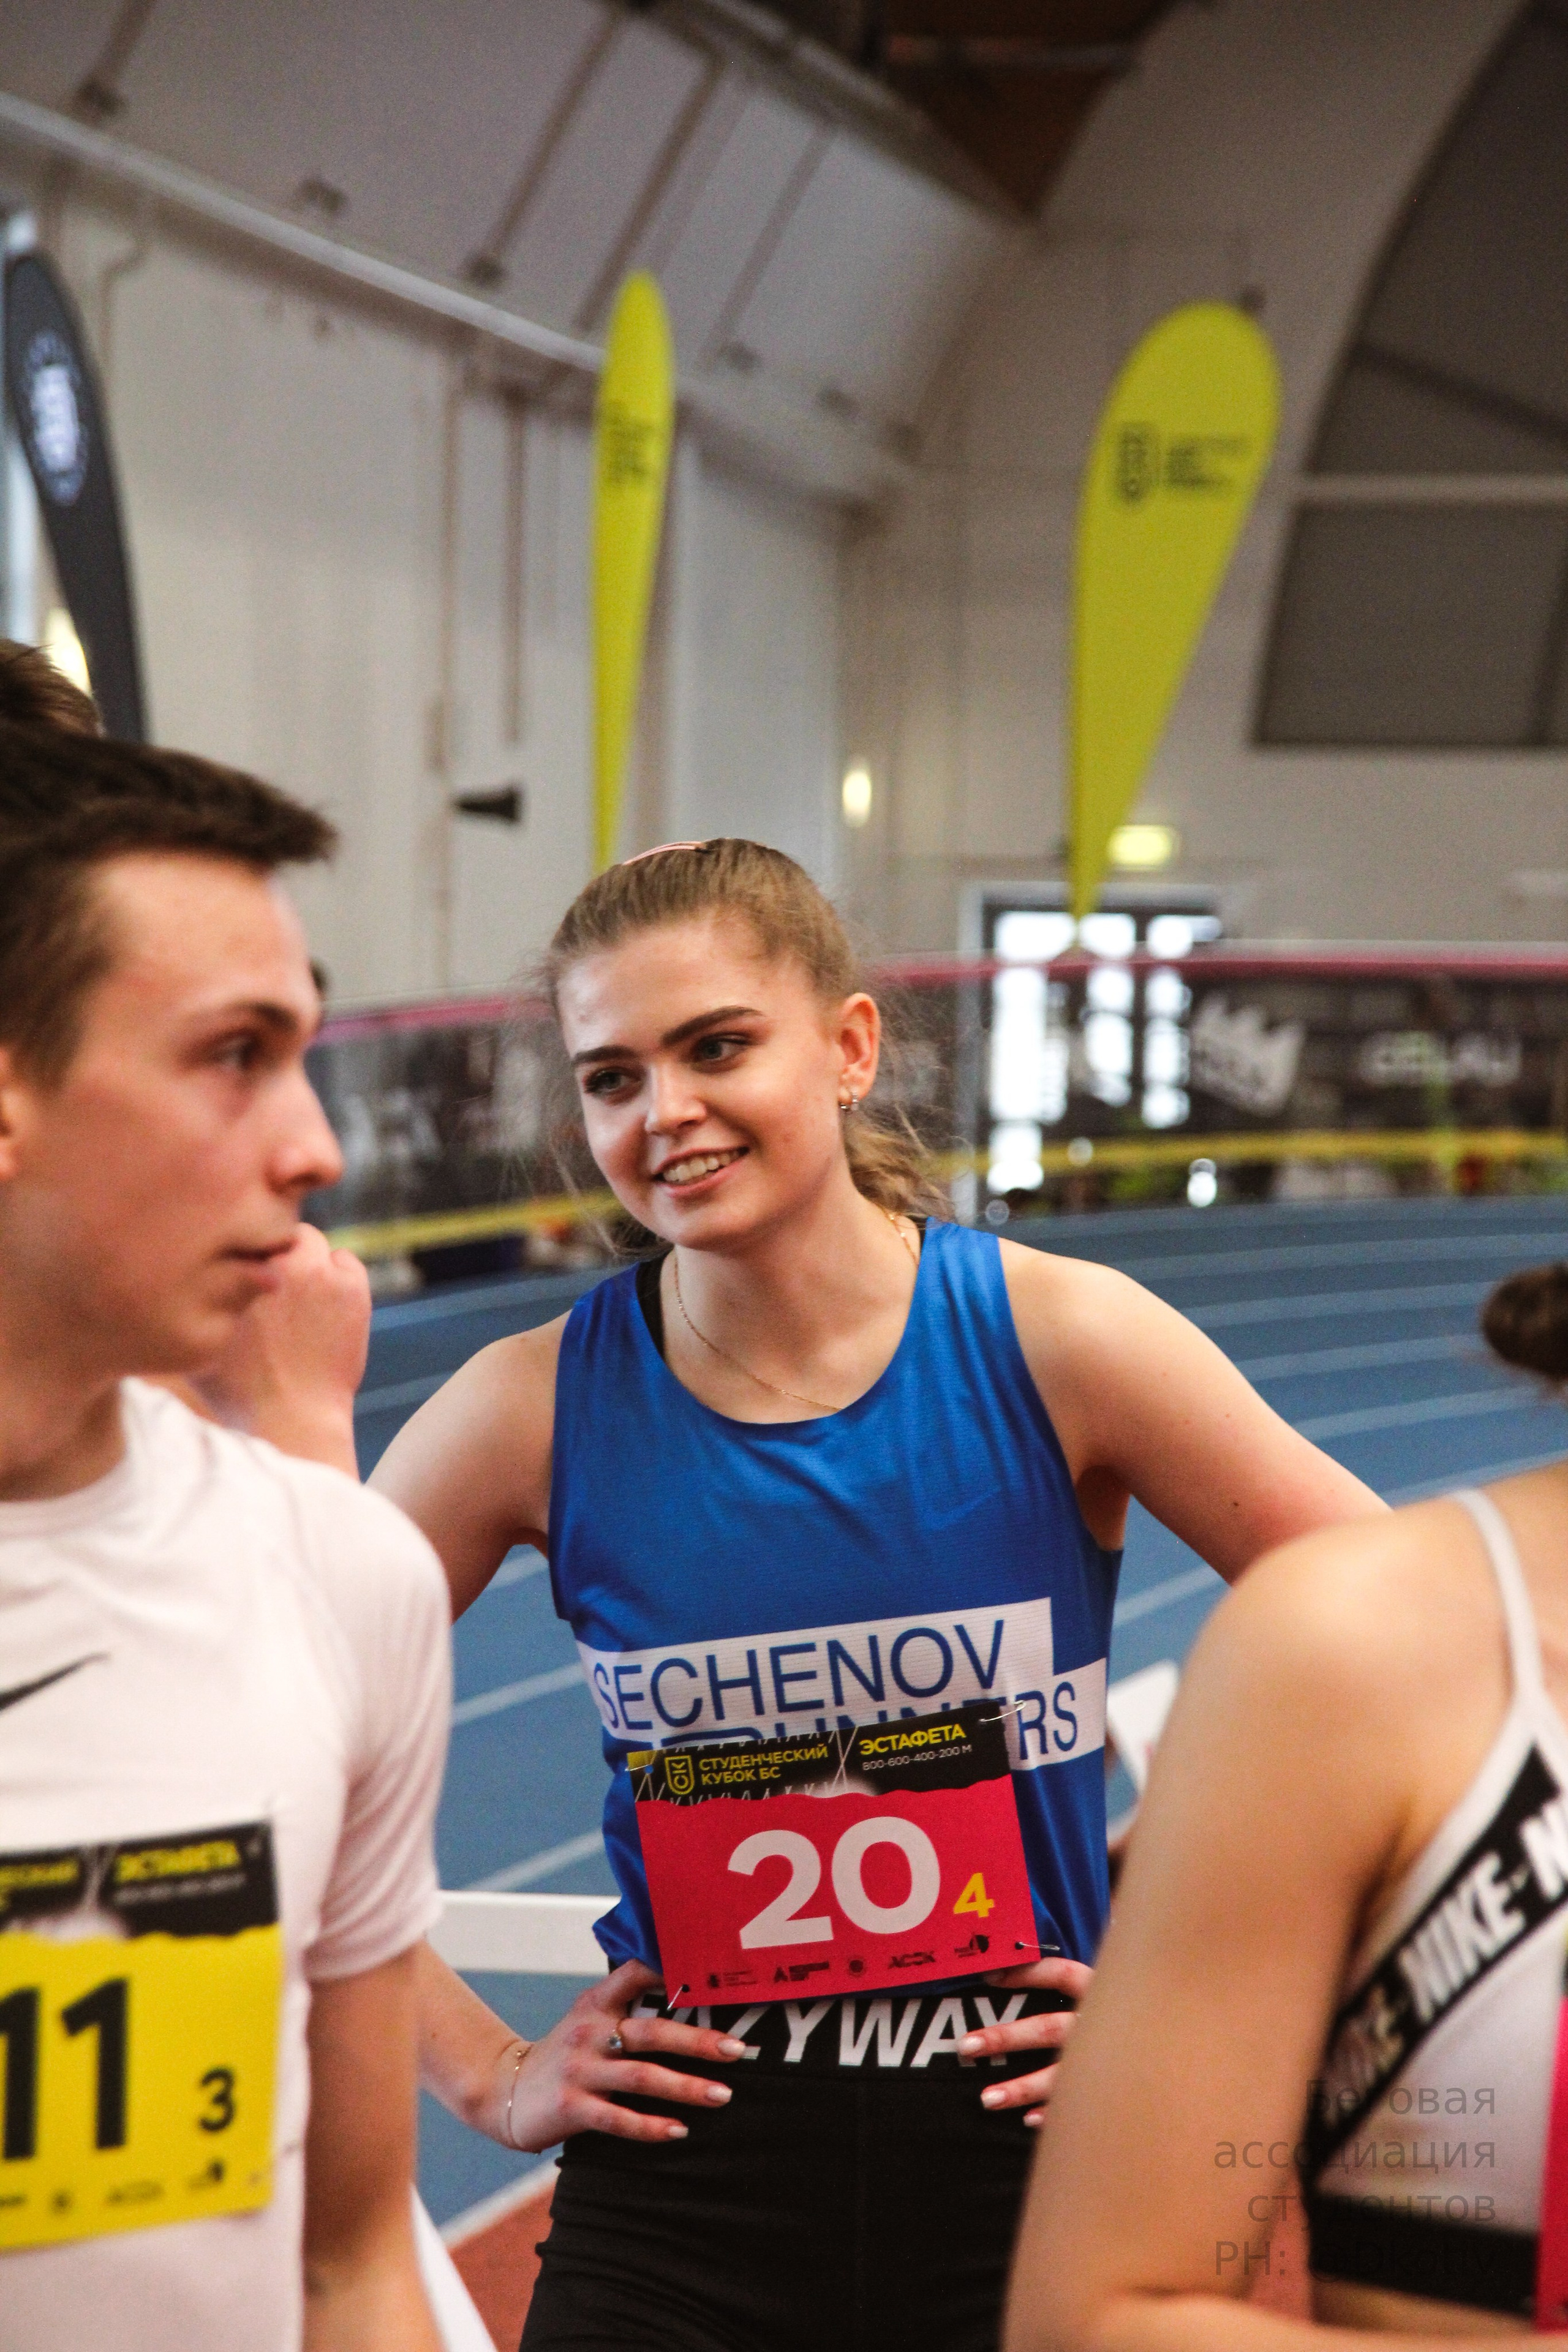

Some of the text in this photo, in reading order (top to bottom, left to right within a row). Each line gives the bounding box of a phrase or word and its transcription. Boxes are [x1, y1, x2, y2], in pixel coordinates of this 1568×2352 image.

[594, 1619, 1005, 1732] SECHENOV
[699, 1743, 829, 1771] СТУДЕНЧЕСКИЙ
[859, 1723, 967, 1755] ЭСТАФЕТА
[862, 1746, 960, 1771] 800-600-400-200
[701, 1766, 782, 1785] КУБОК БС
[727, 1815, 941, 1950] 20
[953, 1872, 995, 1918] 4
[1399, 1850, 1526, 2023] NIKE
[197, 2065, 236, 2132] 3
